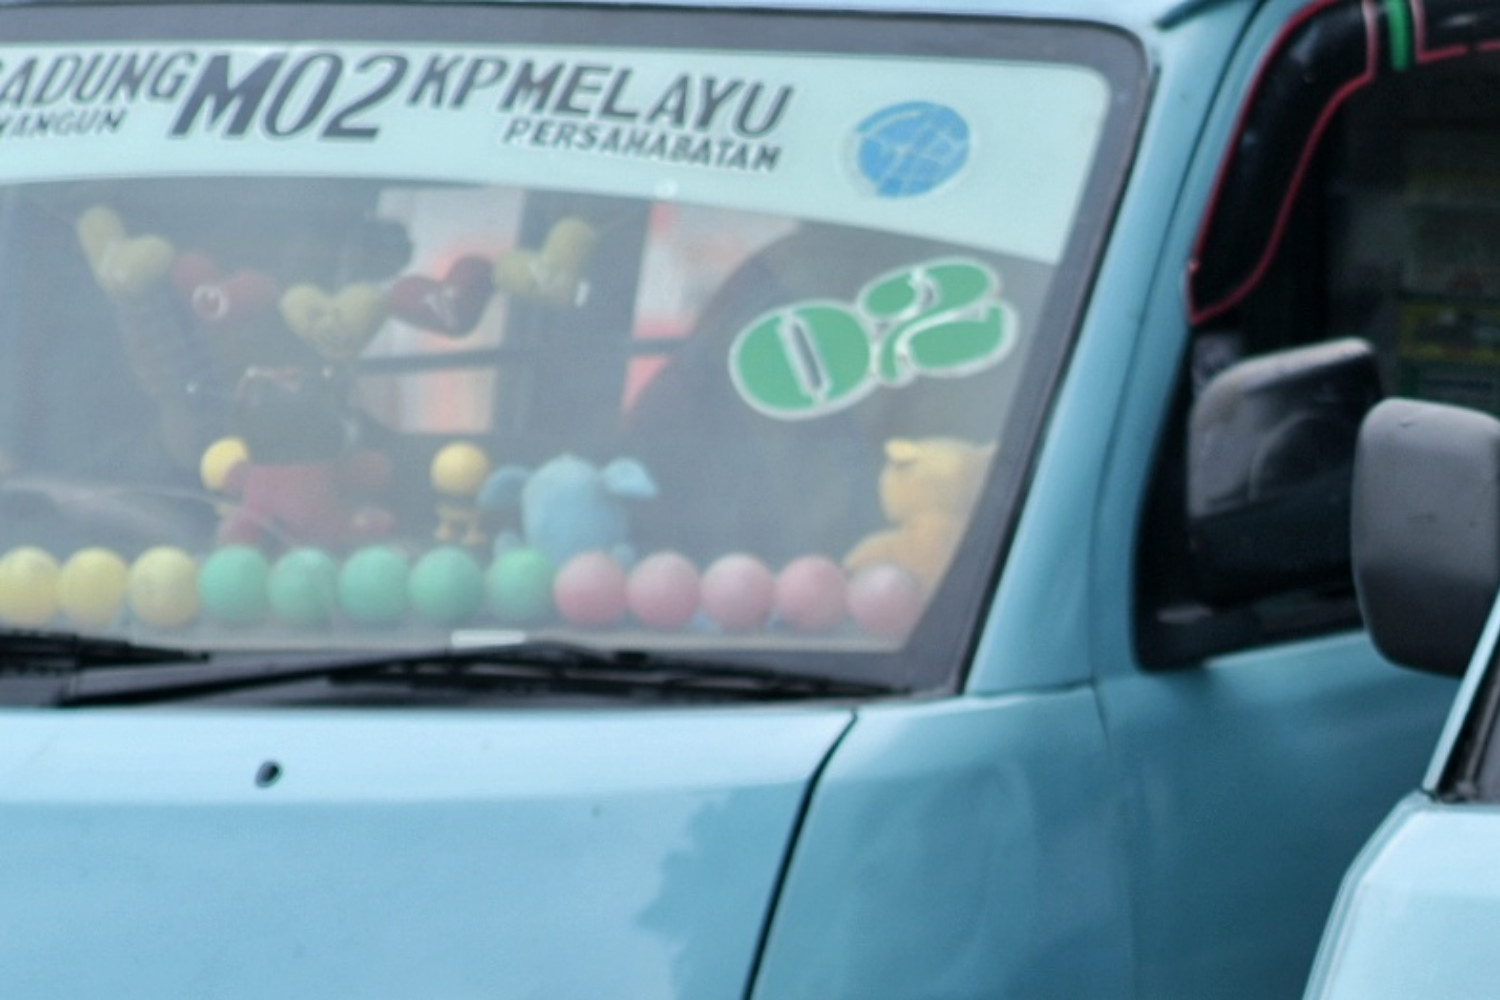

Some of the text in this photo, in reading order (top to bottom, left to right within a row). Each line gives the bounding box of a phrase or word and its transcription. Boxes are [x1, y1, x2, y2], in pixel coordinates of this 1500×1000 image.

[0, 52, 196, 107] ADUNG
[0, 108, 127, 139] ANGUN
[502, 117, 784, 172] PERSAHABATAN
